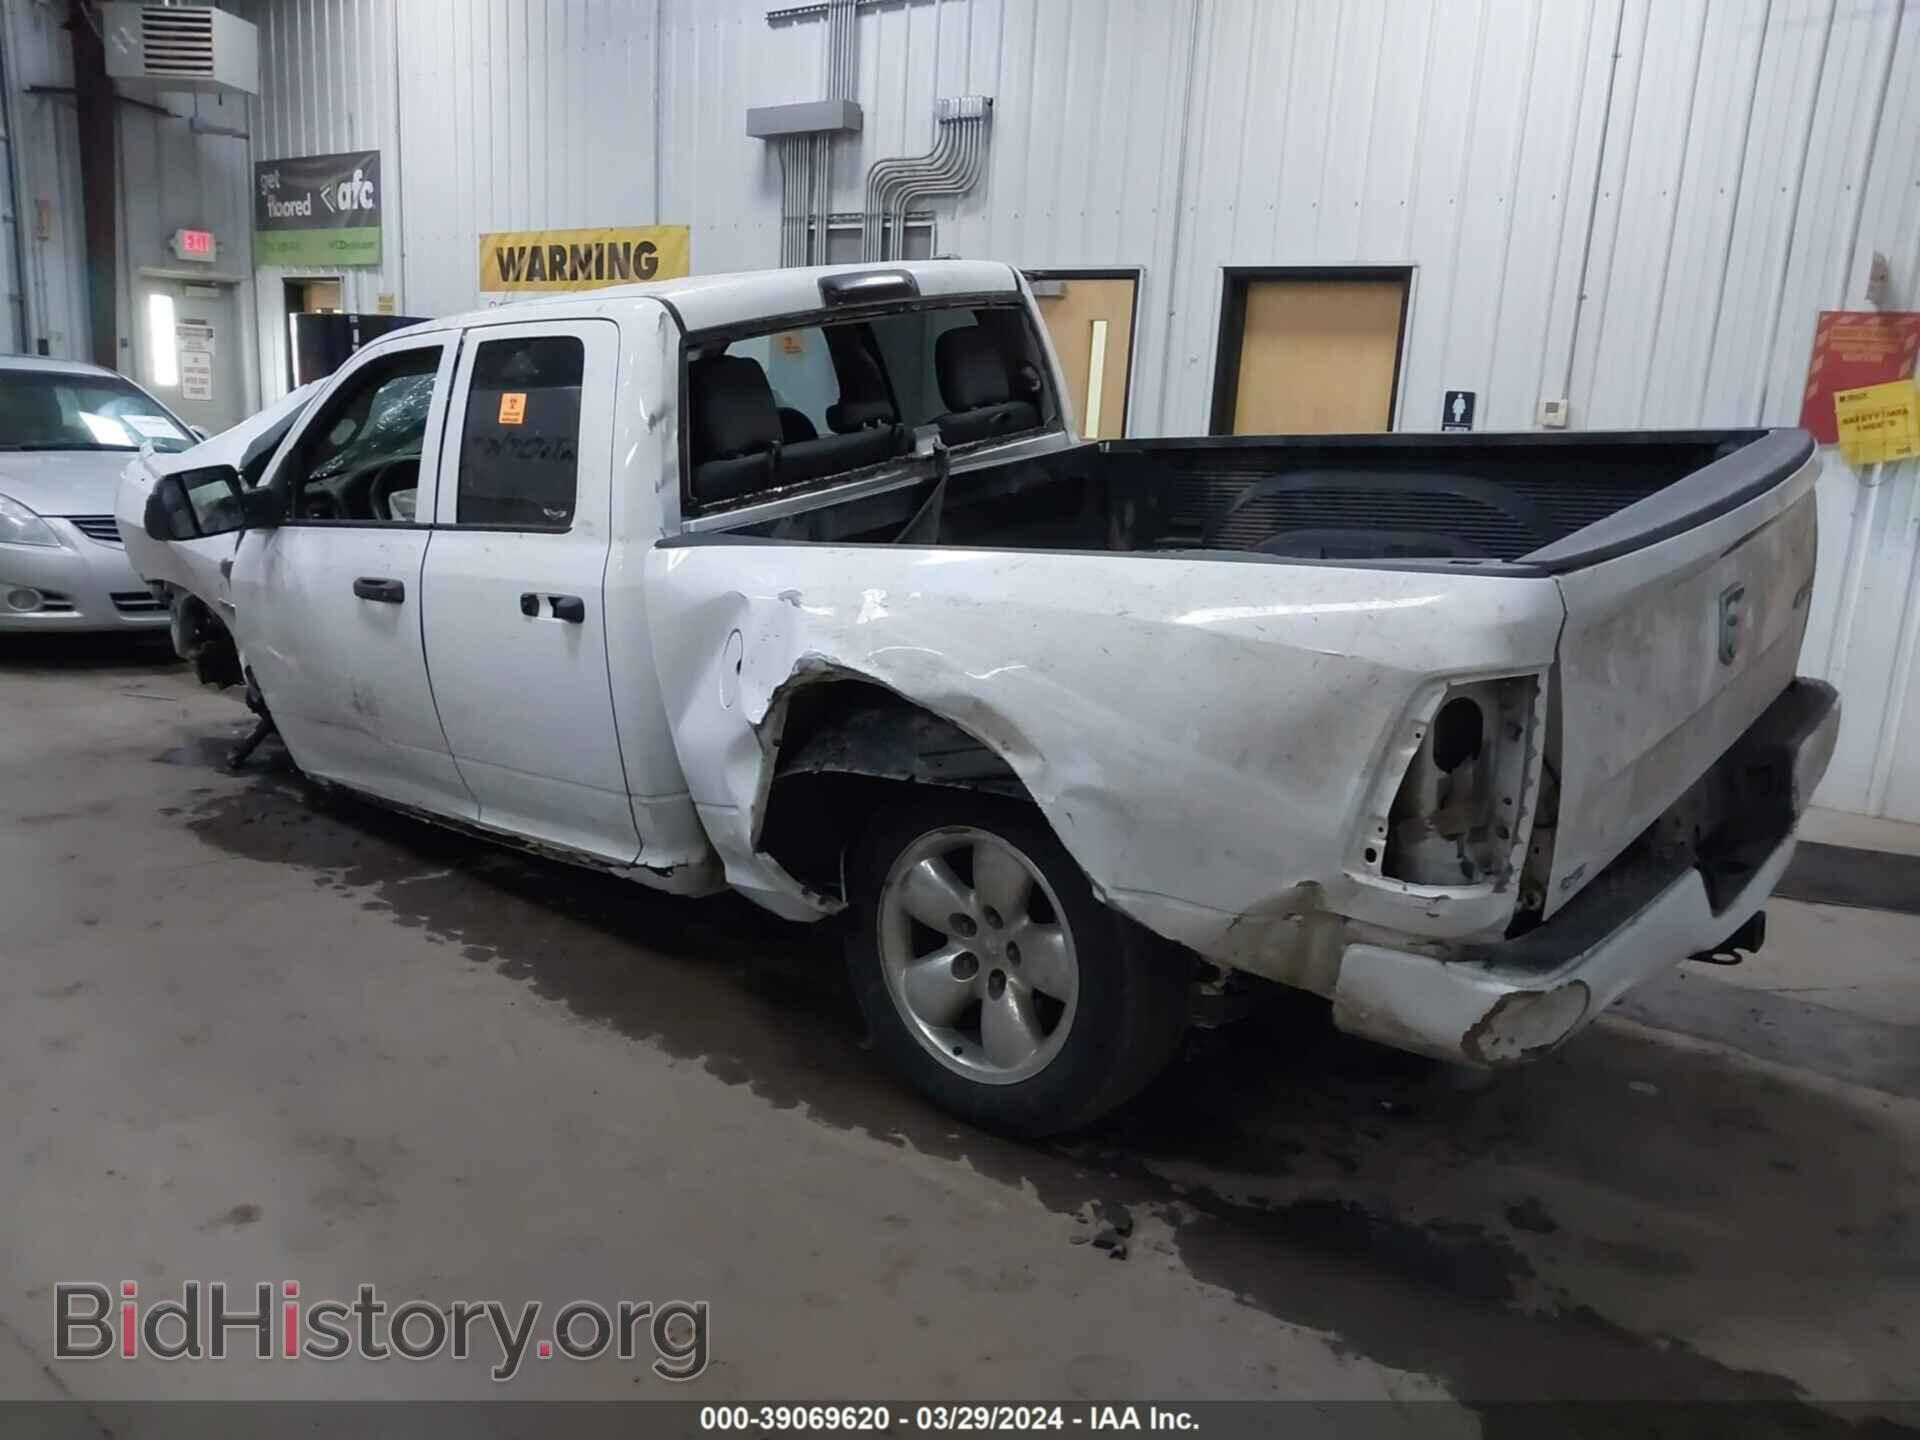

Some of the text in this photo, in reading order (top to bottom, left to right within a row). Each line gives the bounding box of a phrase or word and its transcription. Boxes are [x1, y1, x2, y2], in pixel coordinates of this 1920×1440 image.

[261, 169, 280, 197] get
[337, 168, 375, 211] afc
[267, 192, 312, 218] floored
[496, 240, 660, 283] WARNING
